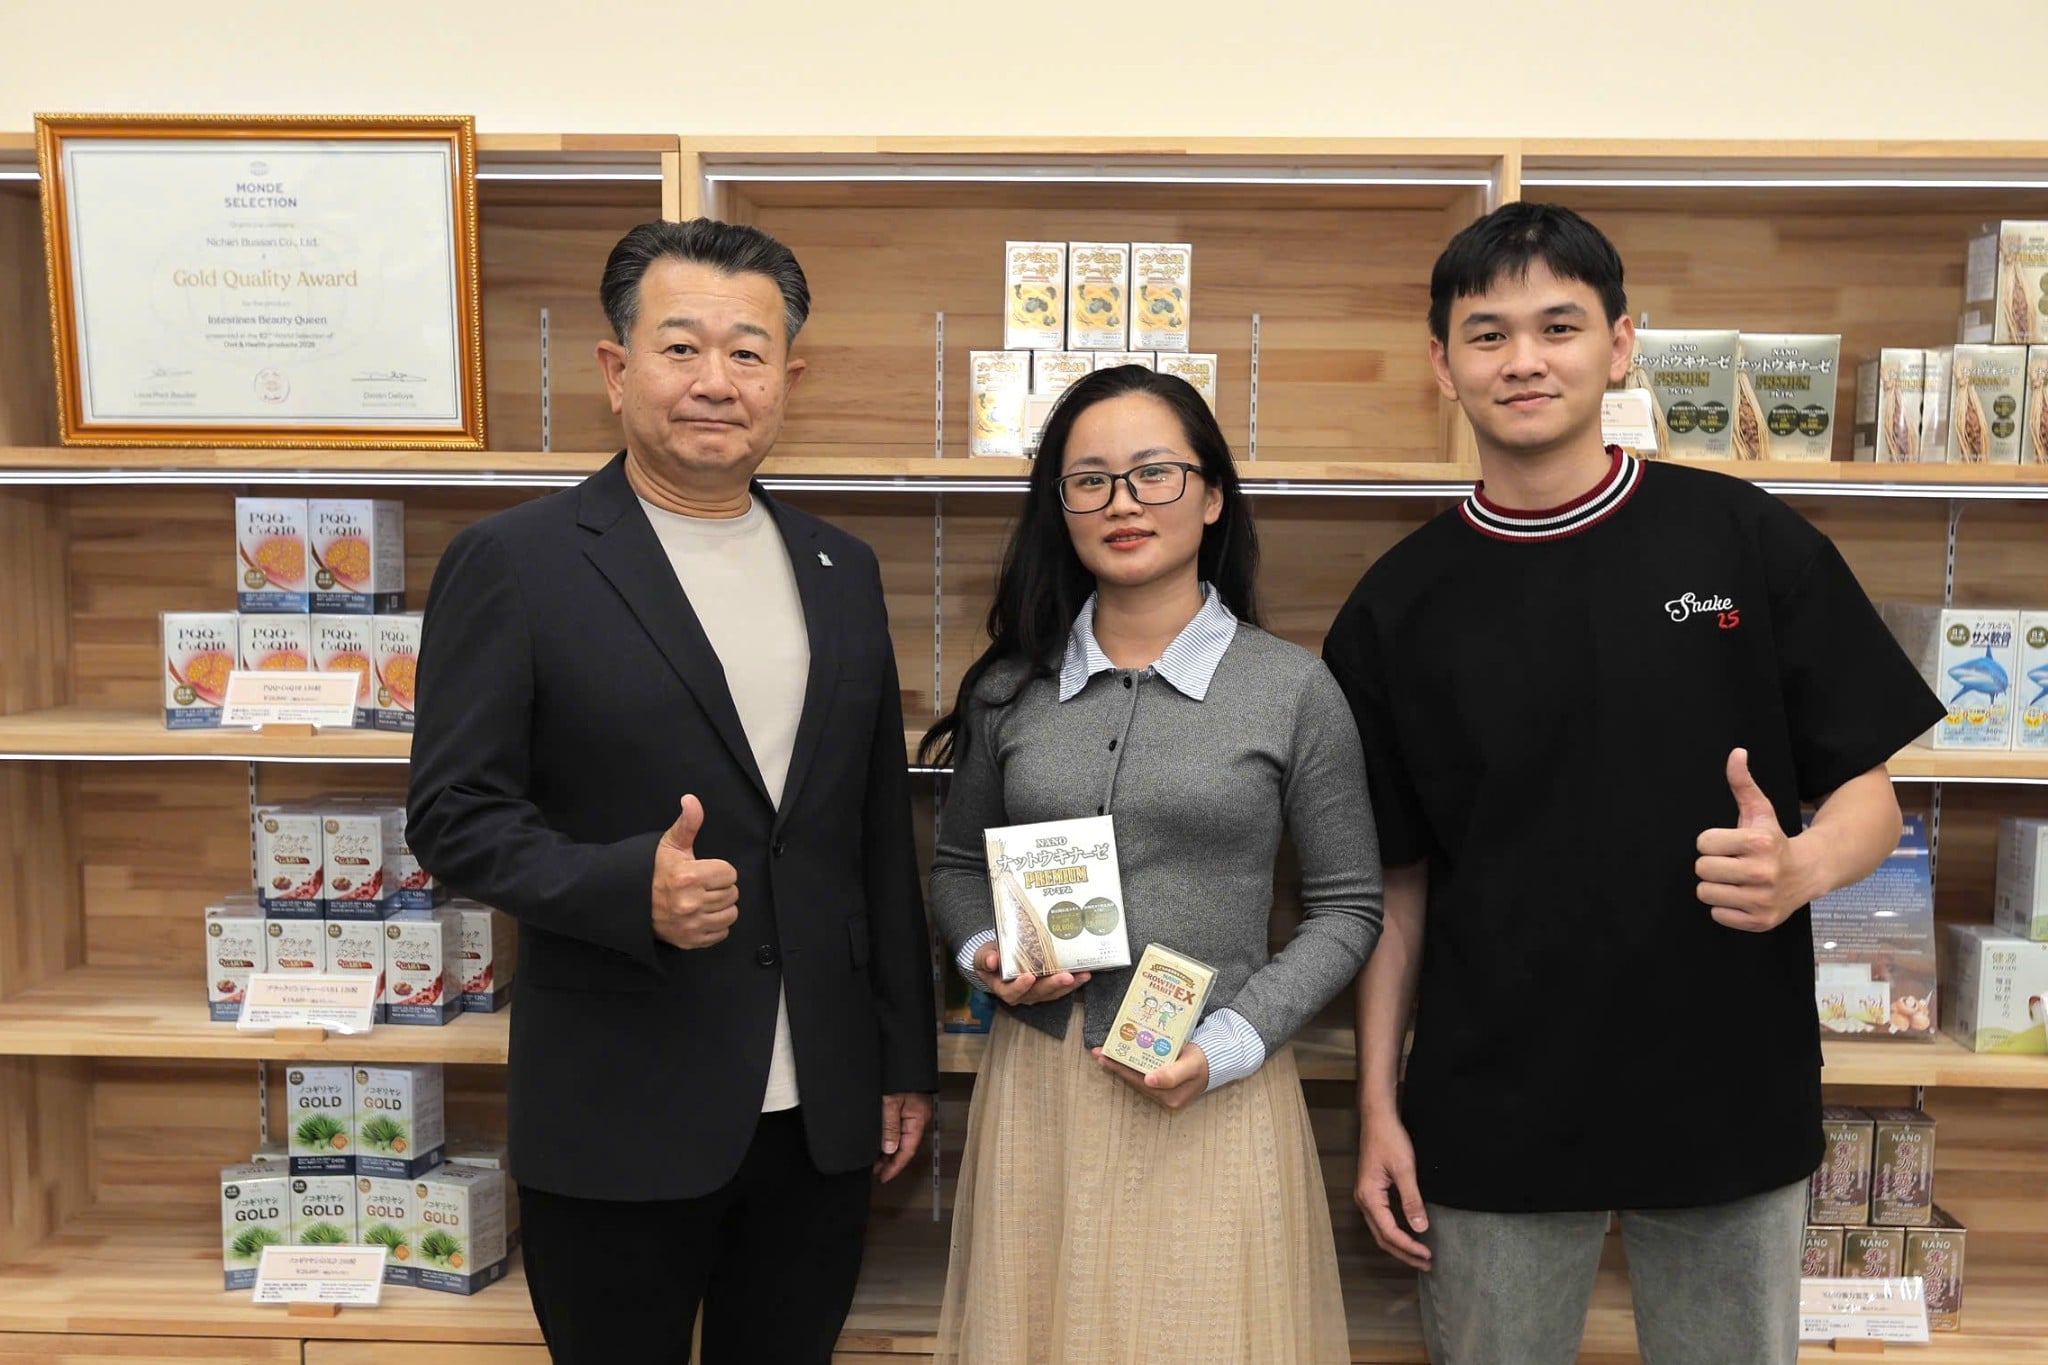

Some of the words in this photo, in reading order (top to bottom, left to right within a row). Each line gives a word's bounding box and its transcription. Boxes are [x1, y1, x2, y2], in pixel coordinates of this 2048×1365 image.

[236, 182, 284, 193] MONDE
[224, 197, 298, 208] SELECTION
[172, 268, 217, 288] Gold
[223, 268, 292, 292] Quality
[296, 269, 358, 288] Award
[258, 314, 292, 326] Beauty
[294, 314, 327, 326] Queen
[1670, 343, 1698, 352] NANO
[1772, 348, 1798, 357] NANO
[1634, 354, 1732, 369] ナットウキナーゼ
[1737, 359, 1833, 374] ナットウキナーゼ
[1654, 371, 1710, 387] PREMIUM
[1755, 375, 1811, 391] PREMIUM
[249, 525, 296, 536] CoQ10
[319, 526, 362, 536] CoQ10
[1664, 591, 1734, 622] Snake
[1717, 609, 1741, 629] 25
[1972, 631, 2012, 647] サメ軟骨
[178, 641, 226, 651] CoQ10
[252, 641, 298, 651] CoQ10
[321, 641, 362, 652] CoQ10
[380, 643, 413, 655] CoQ10
[1036, 836, 1068, 848] NANO
[996, 842, 1110, 872] ナットウキナーゼ
[1023, 864, 1089, 889] PREMIUM
[1043, 886, 1073, 897] プレミアム
[1142, 971, 1176, 990] GROWTH
[1149, 981, 1173, 996] HABIT
[1173, 986, 1196, 1005] EX
[299, 1084, 343, 1094] ノコギリヤシ
[364, 1086, 401, 1097] ノコギリヤシ
[299, 1096, 342, 1109] GOLD
[364, 1096, 402, 1111] GOLD
[1830, 1132, 1858, 1141] NANO
[1891, 1132, 1921, 1142] NANO
[235, 1197, 279, 1207] ノコギリヤシ
[302, 1194, 345, 1203] ノコギリヤシ
[366, 1195, 405, 1205] ノコギリヤシ
[302, 1204, 345, 1217] GOLD
[366, 1204, 405, 1219] GOLD
[424, 1200, 458, 1211] ノコギリヤシ
[235, 1207, 279, 1222] GOLD
[423, 1210, 459, 1226] GOLD
[1807, 1238, 1828, 1248] ANO
[1860, 1238, 1889, 1248] NANO
[1921, 1240, 1951, 1250] NANO
